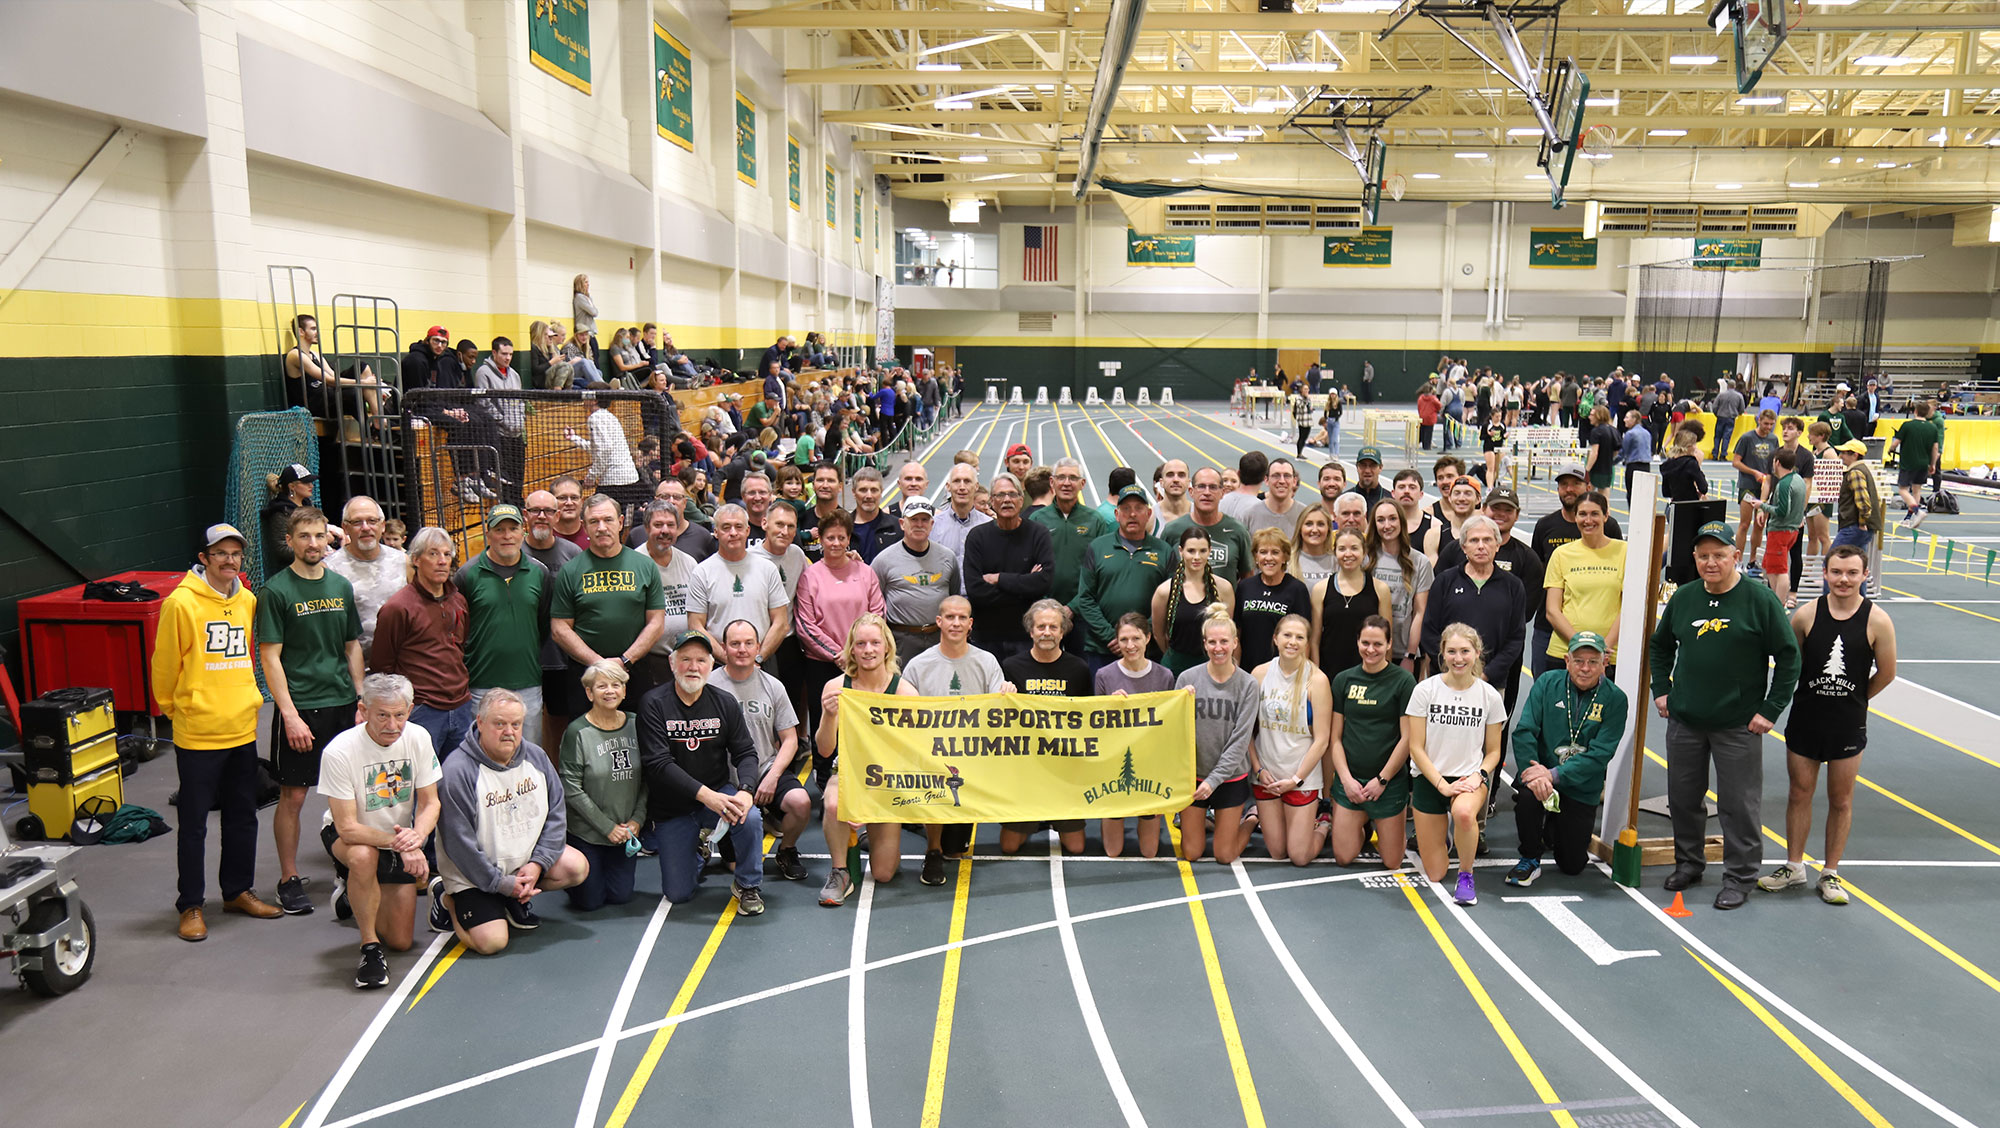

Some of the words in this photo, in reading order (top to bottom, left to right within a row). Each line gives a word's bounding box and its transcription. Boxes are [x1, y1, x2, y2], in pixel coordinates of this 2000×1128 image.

[582, 570, 635, 589] BHSU
[584, 586, 608, 594] TRACK
[295, 597, 345, 614] DISTANCE
[1243, 599, 1289, 615] DISTANCE
[205, 621, 247, 659] BH
[205, 662, 228, 671] TRACK
[1026, 679, 1067, 691] BHSU
[1808, 676, 1832, 689] BLACK
[1836, 677, 1856, 692] HILLS
[869, 706, 980, 729] STADIUM
[986, 708, 1083, 729] SPORTS
[1089, 706, 1163, 729] GRILL
[1429, 703, 1483, 718] BHSU
[666, 717, 721, 731] STURGIS
[1429, 713, 1482, 728] X-COUNTRY
[597, 737, 619, 756] BLACK
[620, 736, 638, 750] HILLS
[931, 736, 1031, 757] ALUMNI
[1037, 736, 1100, 757] MILE
[610, 749, 632, 771] H
[611, 770, 634, 782] STATE
[485, 788, 513, 808] Black
[892, 796, 921, 807] Sports
[924, 789, 947, 803] Grill
[1083, 778, 1129, 805] BLACK
[1133, 778, 1174, 801] HILLS
[1501, 896, 1662, 966] 1
